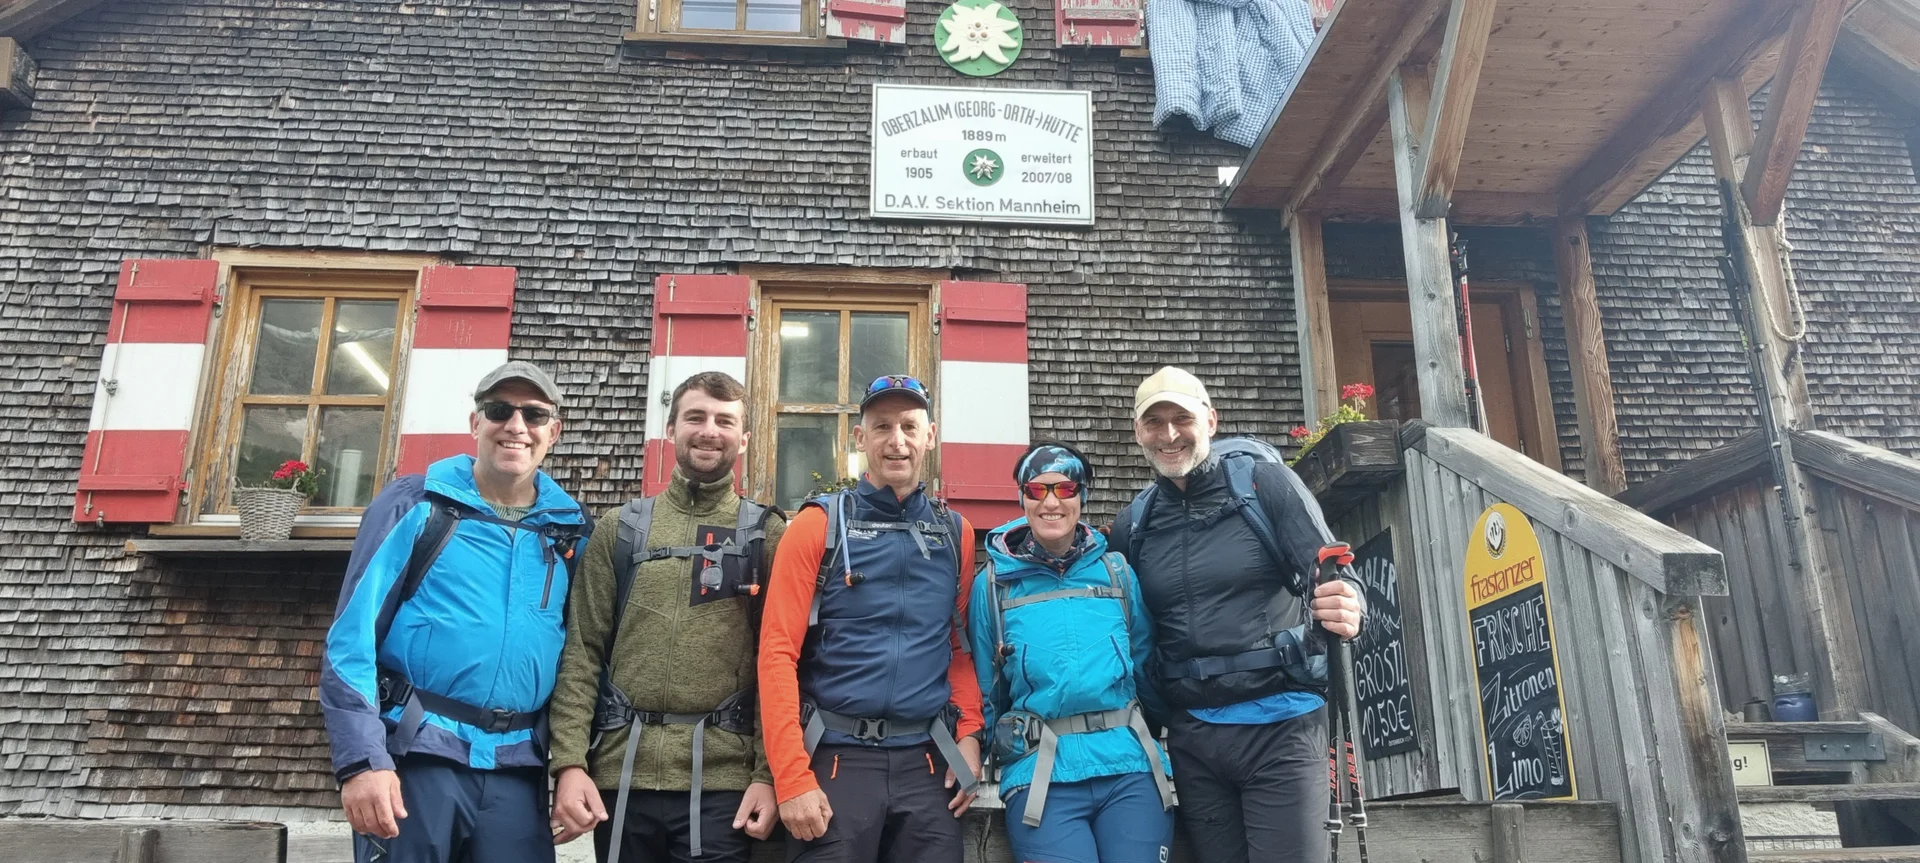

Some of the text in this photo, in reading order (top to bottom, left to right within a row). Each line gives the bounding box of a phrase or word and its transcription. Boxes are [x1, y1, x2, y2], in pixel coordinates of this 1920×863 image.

[881, 102, 953, 137] OBERZALIM
[961, 129, 993, 141] 1889
[900, 148, 938, 159] erbaut
[1021, 153, 1072, 164] erweitert
[905, 167, 933, 179] 1905
[1021, 172, 1073, 184] 2007/08
[885, 194, 1081, 215] D.A.V. Sektion Mannheim
[1357, 556, 1396, 607] OLER
[1470, 555, 1536, 603] frastanzer
[1473, 594, 1551, 667] FRISCHE
[1354, 639, 1408, 701] GRÖSTL
[1482, 666, 1556, 739] Zitronen
[1344, 741, 1358, 783] LEKI
[1488, 741, 1545, 800] Limo
[1733, 756, 1748, 771] g!
